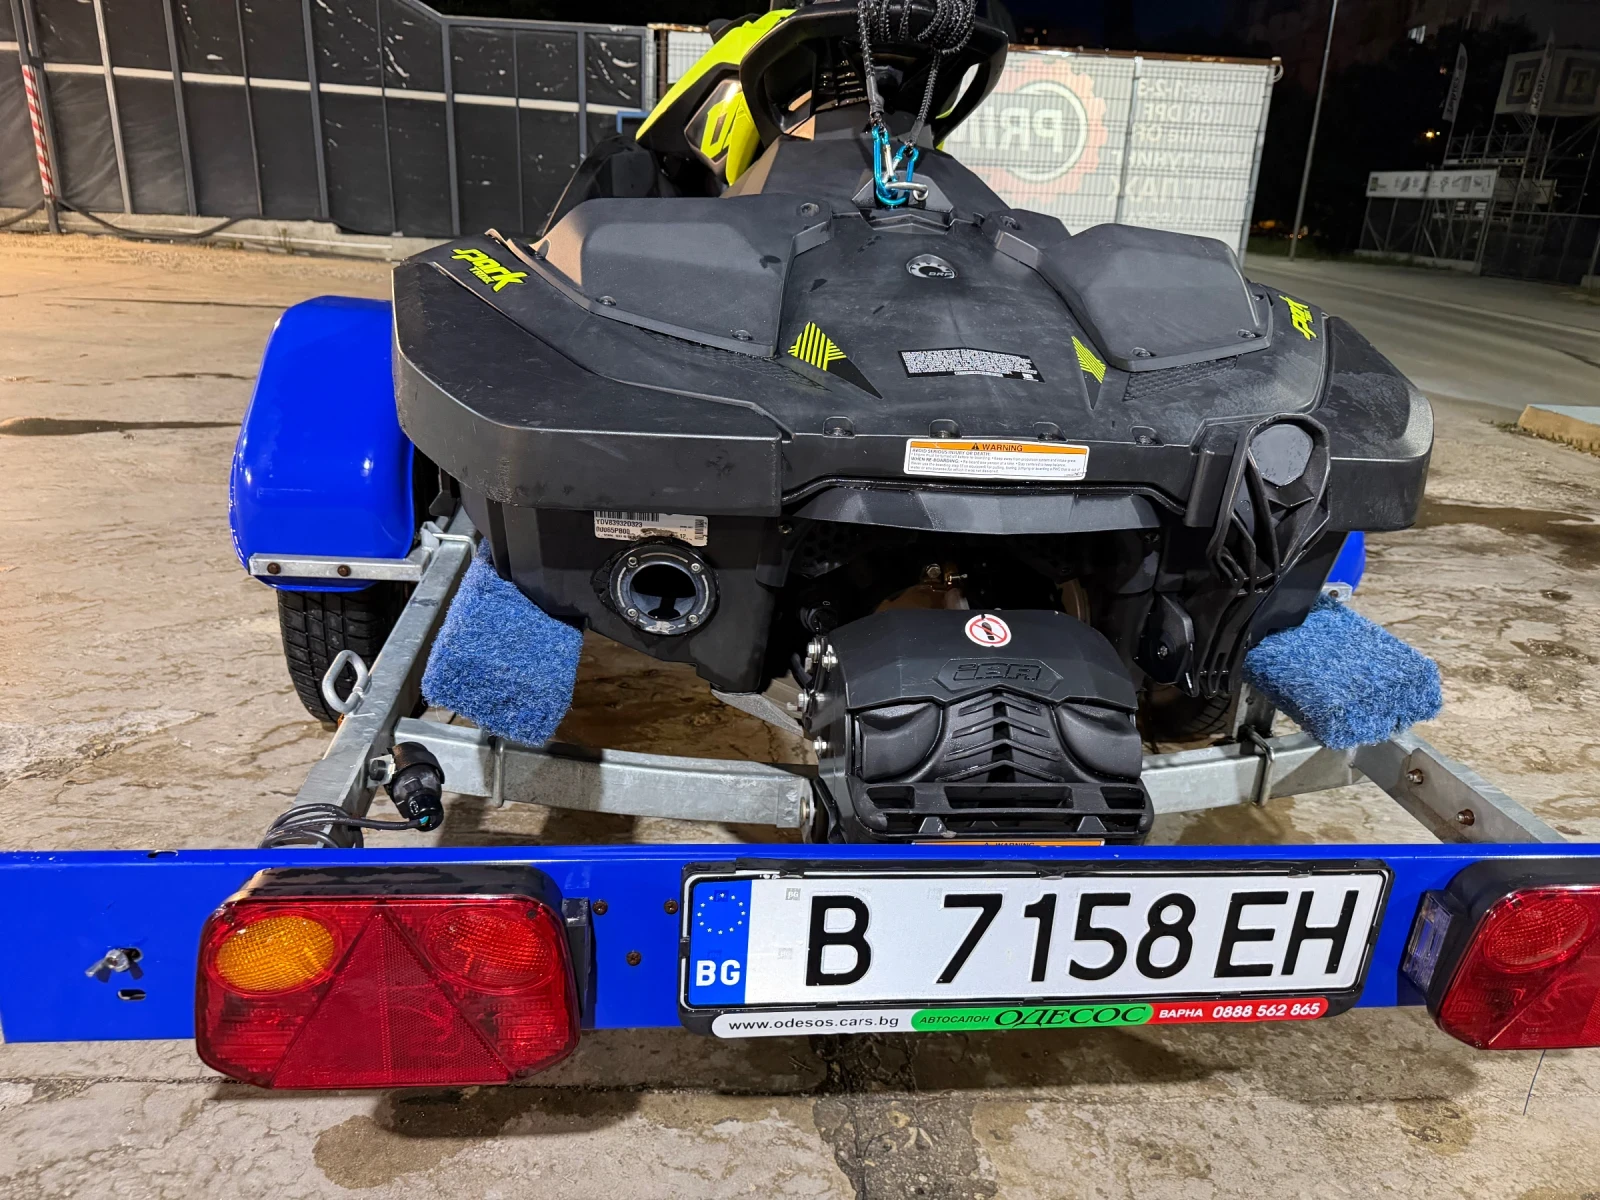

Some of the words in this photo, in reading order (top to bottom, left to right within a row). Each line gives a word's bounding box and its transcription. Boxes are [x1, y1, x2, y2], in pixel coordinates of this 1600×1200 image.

[982, 443, 1023, 452] WARNING
[805, 894, 872, 987] B
[935, 891, 1196, 984] 7158
[1213, 889, 1360, 979] EH
[695, 959, 741, 987] BG
[918, 1014, 991, 1025] АВТОСАЛОН
[994, 1005, 1148, 1028] ОДЕСОС
[1158, 1007, 1204, 1019] ВАРНА
[1212, 1004, 1253, 1019] 0888
[1254, 1003, 1287, 1018] 562
[1290, 1002, 1320, 1016] 865
[728, 1015, 900, 1031] www.odesos.cars.bg
